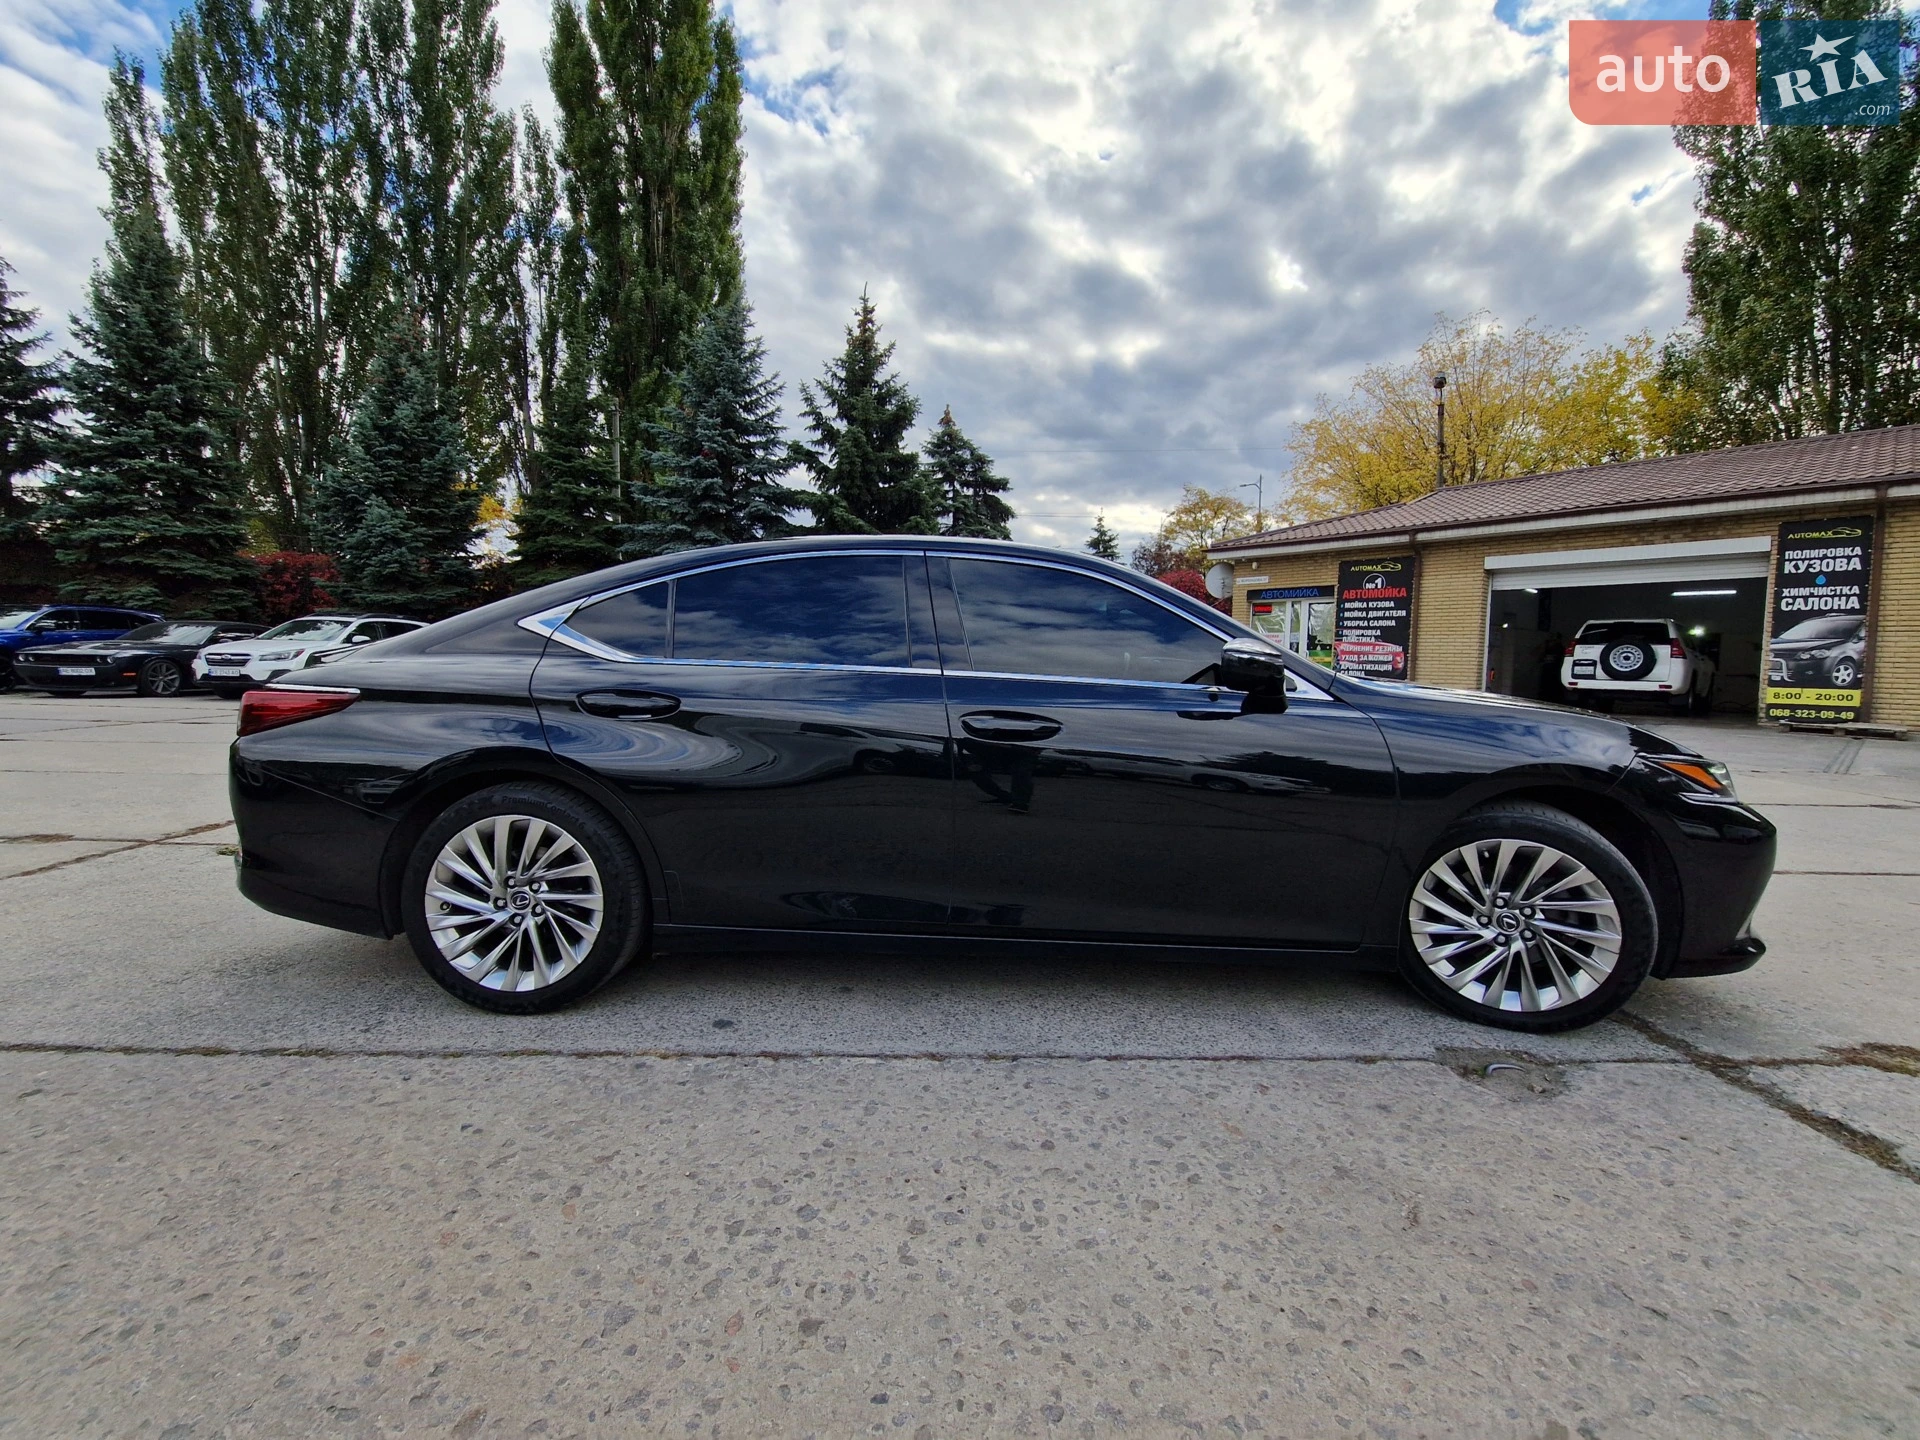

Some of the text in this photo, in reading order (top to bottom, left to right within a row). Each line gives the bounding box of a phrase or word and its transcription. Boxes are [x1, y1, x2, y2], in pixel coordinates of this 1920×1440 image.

[1787, 530, 1833, 539] AUTOMAX
[1784, 546, 1862, 560] ПОЛИРОВКА
[1783, 557, 1862, 574] КУЗОВА
[1260, 588, 1319, 599] АВТОМИЙКА
[1342, 586, 1407, 599] АВТОМОЙКА
[1781, 585, 1860, 597] ХИМЧИСТКА
[1344, 600, 1368, 608] МОЙКА
[1780, 596, 1860, 611] САЛОНА
[1344, 610, 1407, 618] МОЙКА ДВИГАТЕЛЯ
[1773, 692, 1802, 700] 8:00
[1815, 693, 1854, 702] 20:00
[1769, 708, 1855, 720] 068-323-09-49
